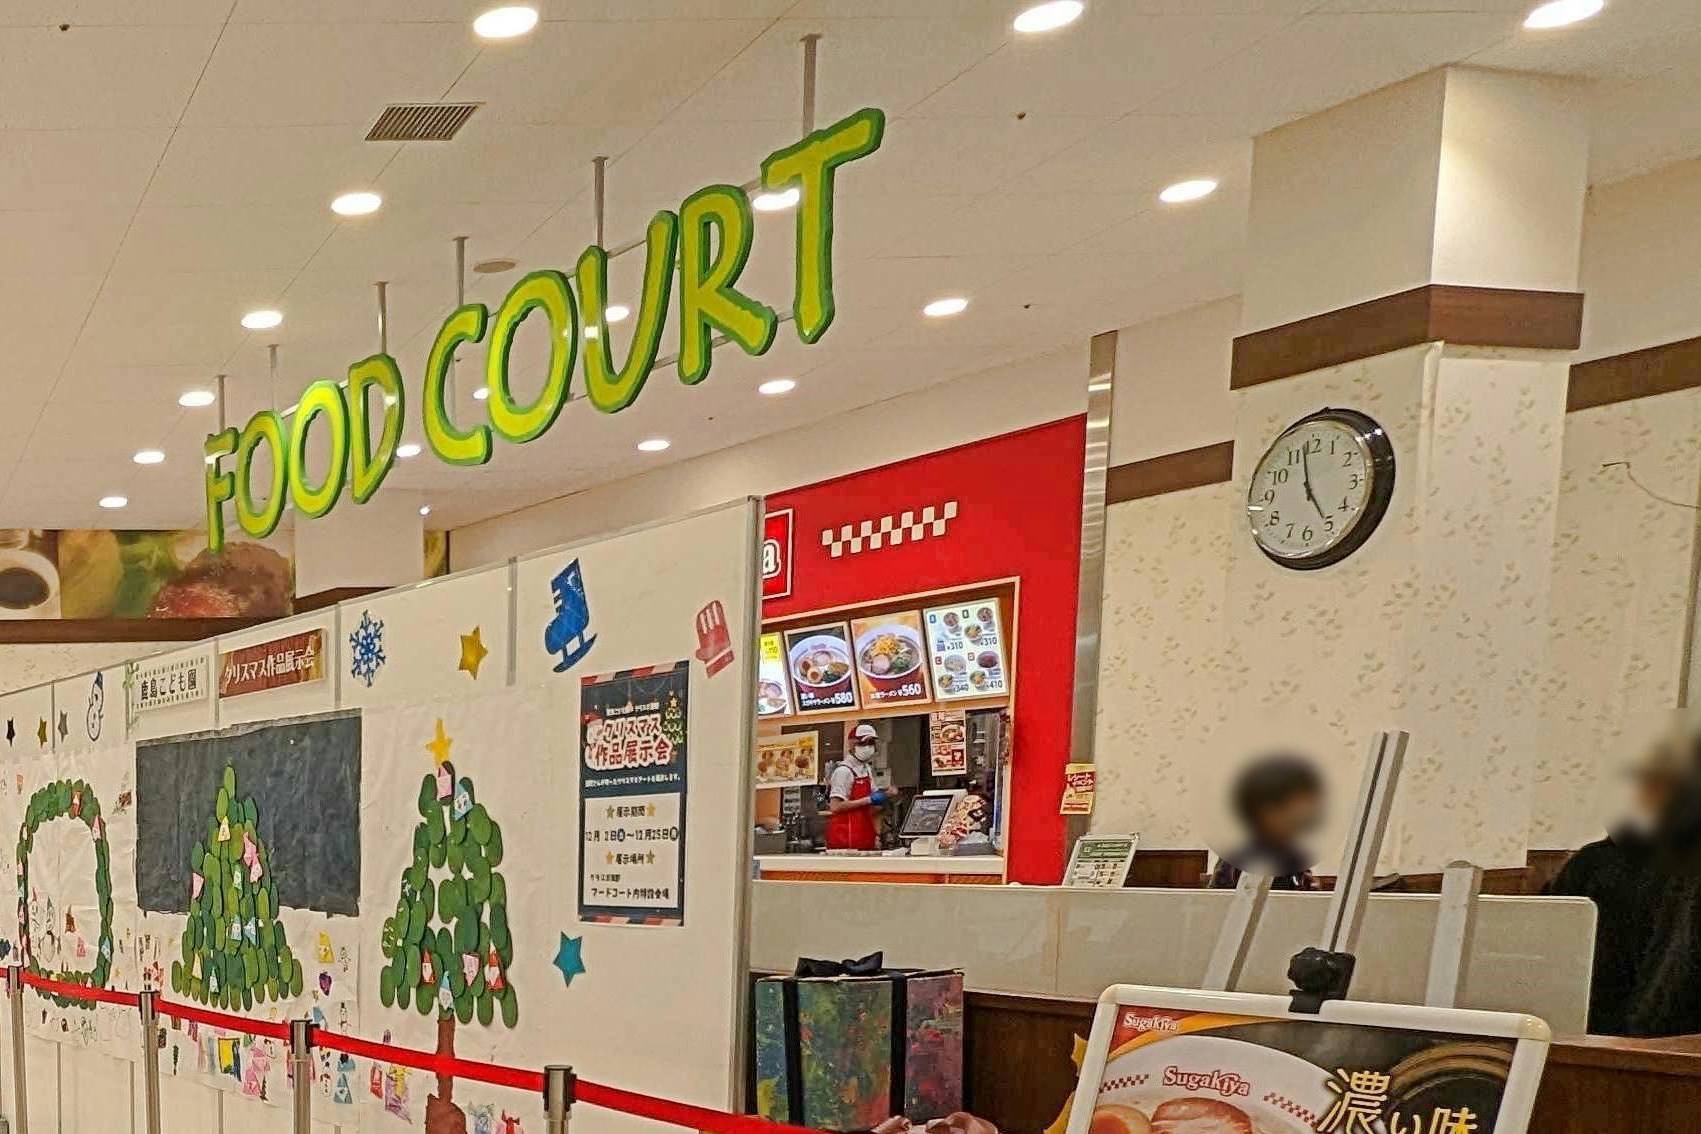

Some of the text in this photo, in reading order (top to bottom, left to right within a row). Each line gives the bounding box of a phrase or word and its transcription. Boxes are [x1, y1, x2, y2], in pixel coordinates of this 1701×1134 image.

[205, 107, 886, 554] FOOD COURT
[1305, 438, 1322, 454] 12
[1329, 440, 1335, 455] 1
[1288, 448, 1300, 466] 11
[1342, 451, 1353, 467] 2
[1272, 468, 1289, 485] 10
[1349, 473, 1359, 490] 3
[1263, 489, 1275, 505] 9
[1337, 496, 1349, 512] 4
[1269, 510, 1280, 526] 8
[1323, 515, 1334, 532] 5
[1285, 523, 1296, 539] 7
[1302, 525, 1313, 541] 6
[224, 645, 315, 684] クリスマス作品展示会
[604, 714, 661, 739] クリスマス
[595, 736, 672, 767] 作品展示会
[1122, 1012, 1180, 1033] Sugakiya
[1162, 1066, 1250, 1097] Sugakiya
